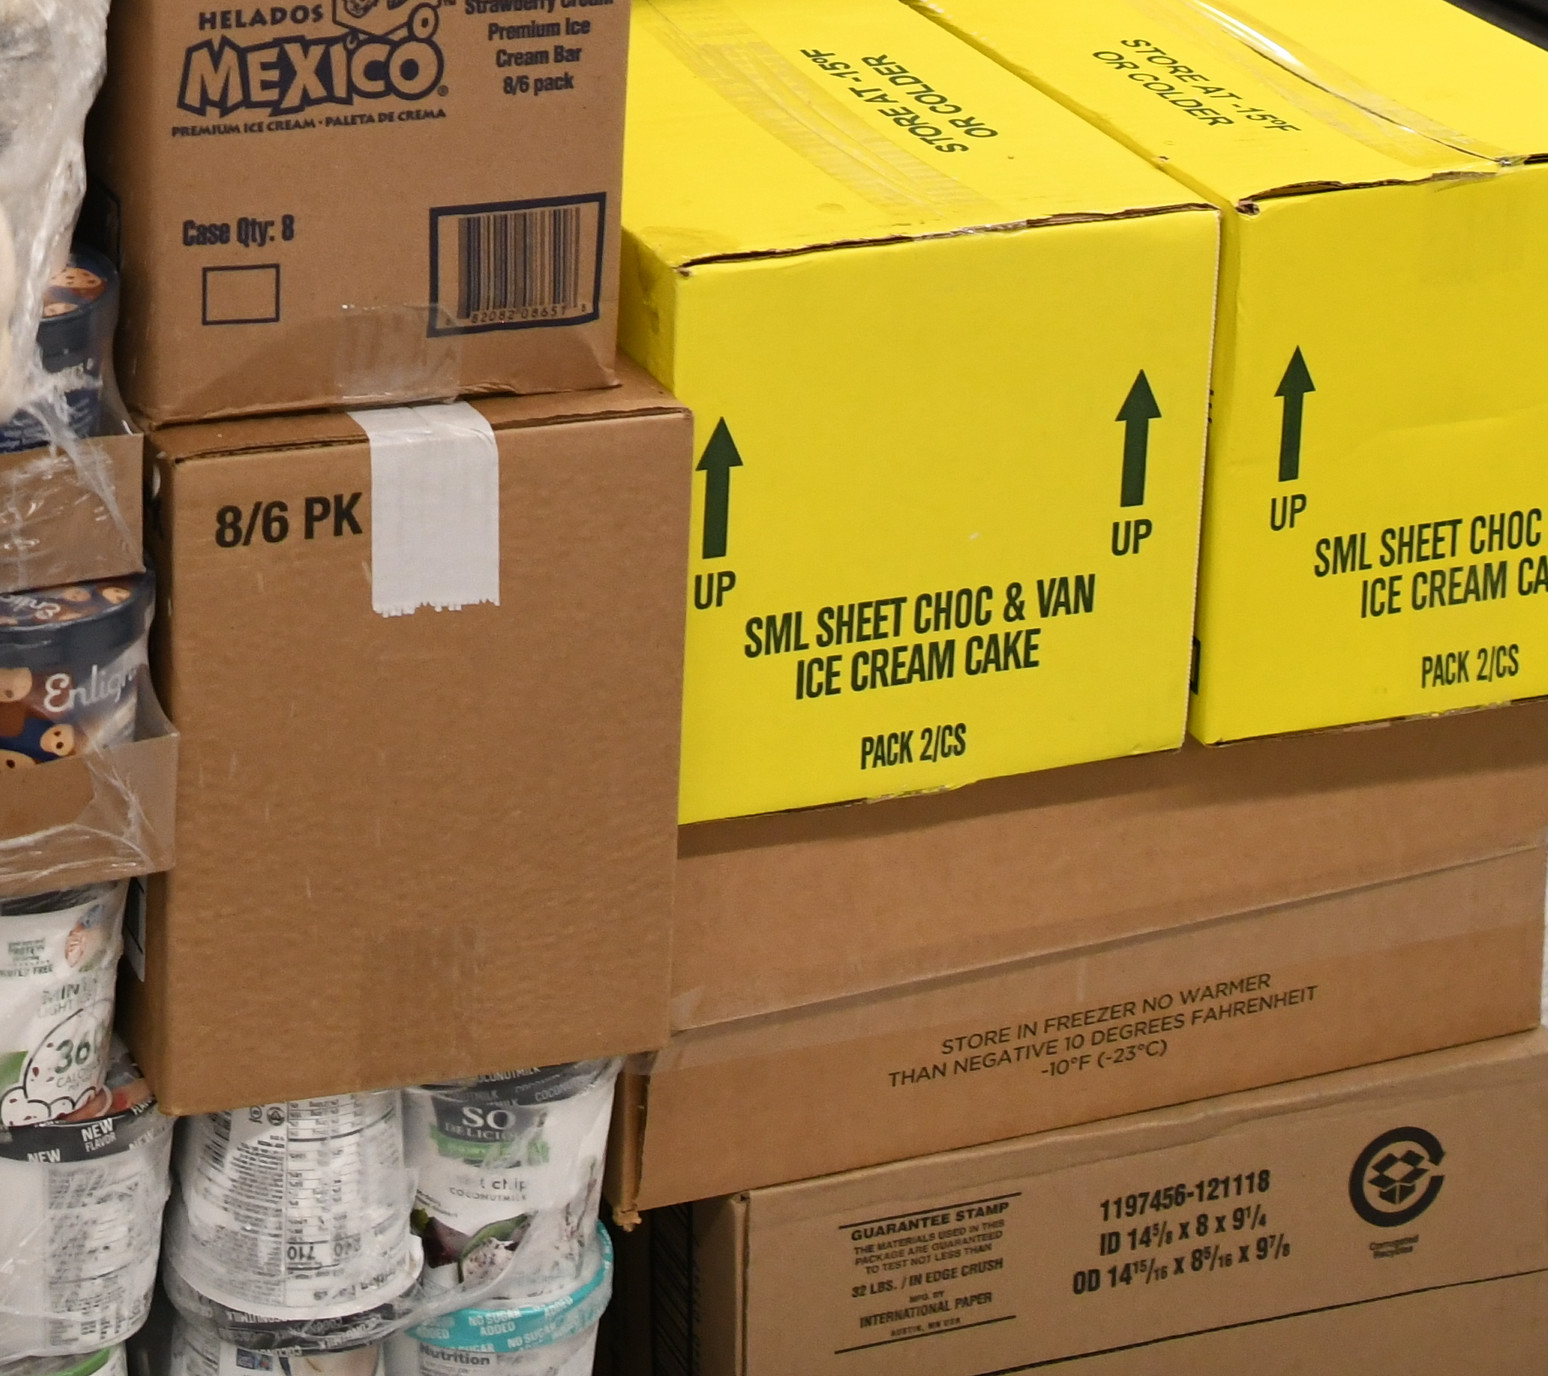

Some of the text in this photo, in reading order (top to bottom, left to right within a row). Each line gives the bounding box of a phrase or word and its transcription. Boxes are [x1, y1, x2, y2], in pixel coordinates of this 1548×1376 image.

[198, 4, 323, 30] HELADOS
[488, 18, 590, 40] Premium Ice
[177, 34, 445, 117] MEXICO
[496, 46, 581, 67] Cream Bar
[1121, 39, 1211, 82] STORE
[1201, 85, 1242, 100] AT
[503, 72, 573, 95] 8/6 pack
[848, 87, 894, 103] AT
[862, 54, 998, 137] OR COLDER
[1092, 51, 1234, 126] OR COLDER
[172, 108, 446, 137] PREMIUM ICE CREAM PALETA DE CREMA
[879, 107, 969, 153] STORE
[183, 214, 294, 248] Case Qty: 8
[216, 492, 363, 548] 8/6 PK
[1269, 493, 1307, 531] UP
[1111, 518, 1152, 556] UP
[1313, 533, 1372, 577] SML
[1380, 519, 1462, 568] SHEET
[1470, 508, 1542, 554] CHOC
[693, 570, 736, 610] UP
[1360, 575, 1401, 619] ICE
[1411, 561, 1506, 610] CREAM
[744, 573, 1096, 658] SML SHEET CHOC & VAN
[796, 628, 1041, 700] ICE CREAM CAKE
[1421, 643, 1520, 688] PACK 2/CS
[860, 722, 966, 769] PACK 2/CS
[941, 972, 1271, 1055] STORE IN FREEZER NO WARMER
[888, 986, 1318, 1087] THAN NEGATIVE 10 DEGREES FAHRENHEIT
[81, 1118, 114, 1142] NEW
[462, 1106, 516, 1131] SO
[85, 1132, 117, 1152] FLAVOR
[1100, 1169, 1270, 1221] 1197456-121118
[851, 1202, 1009, 1241] GUARANTEE STAMP
[855, 1219, 1005, 1255] THE MATERIALS USED IN THIS
[855, 1231, 1003, 1265] PACKAGE ARE GUARANTEED
[866, 1243, 992, 1274] TO TEST NOT LESS THAN
[1100, 1231, 1121, 1256] ID
[852, 1258, 1004, 1298] 32 LBS. IN EDGE CRUSH
[1073, 1268, 1100, 1294] OD
[860, 1300, 951, 1328] INTERNATIONAL
[955, 1292, 992, 1309] PAPER
